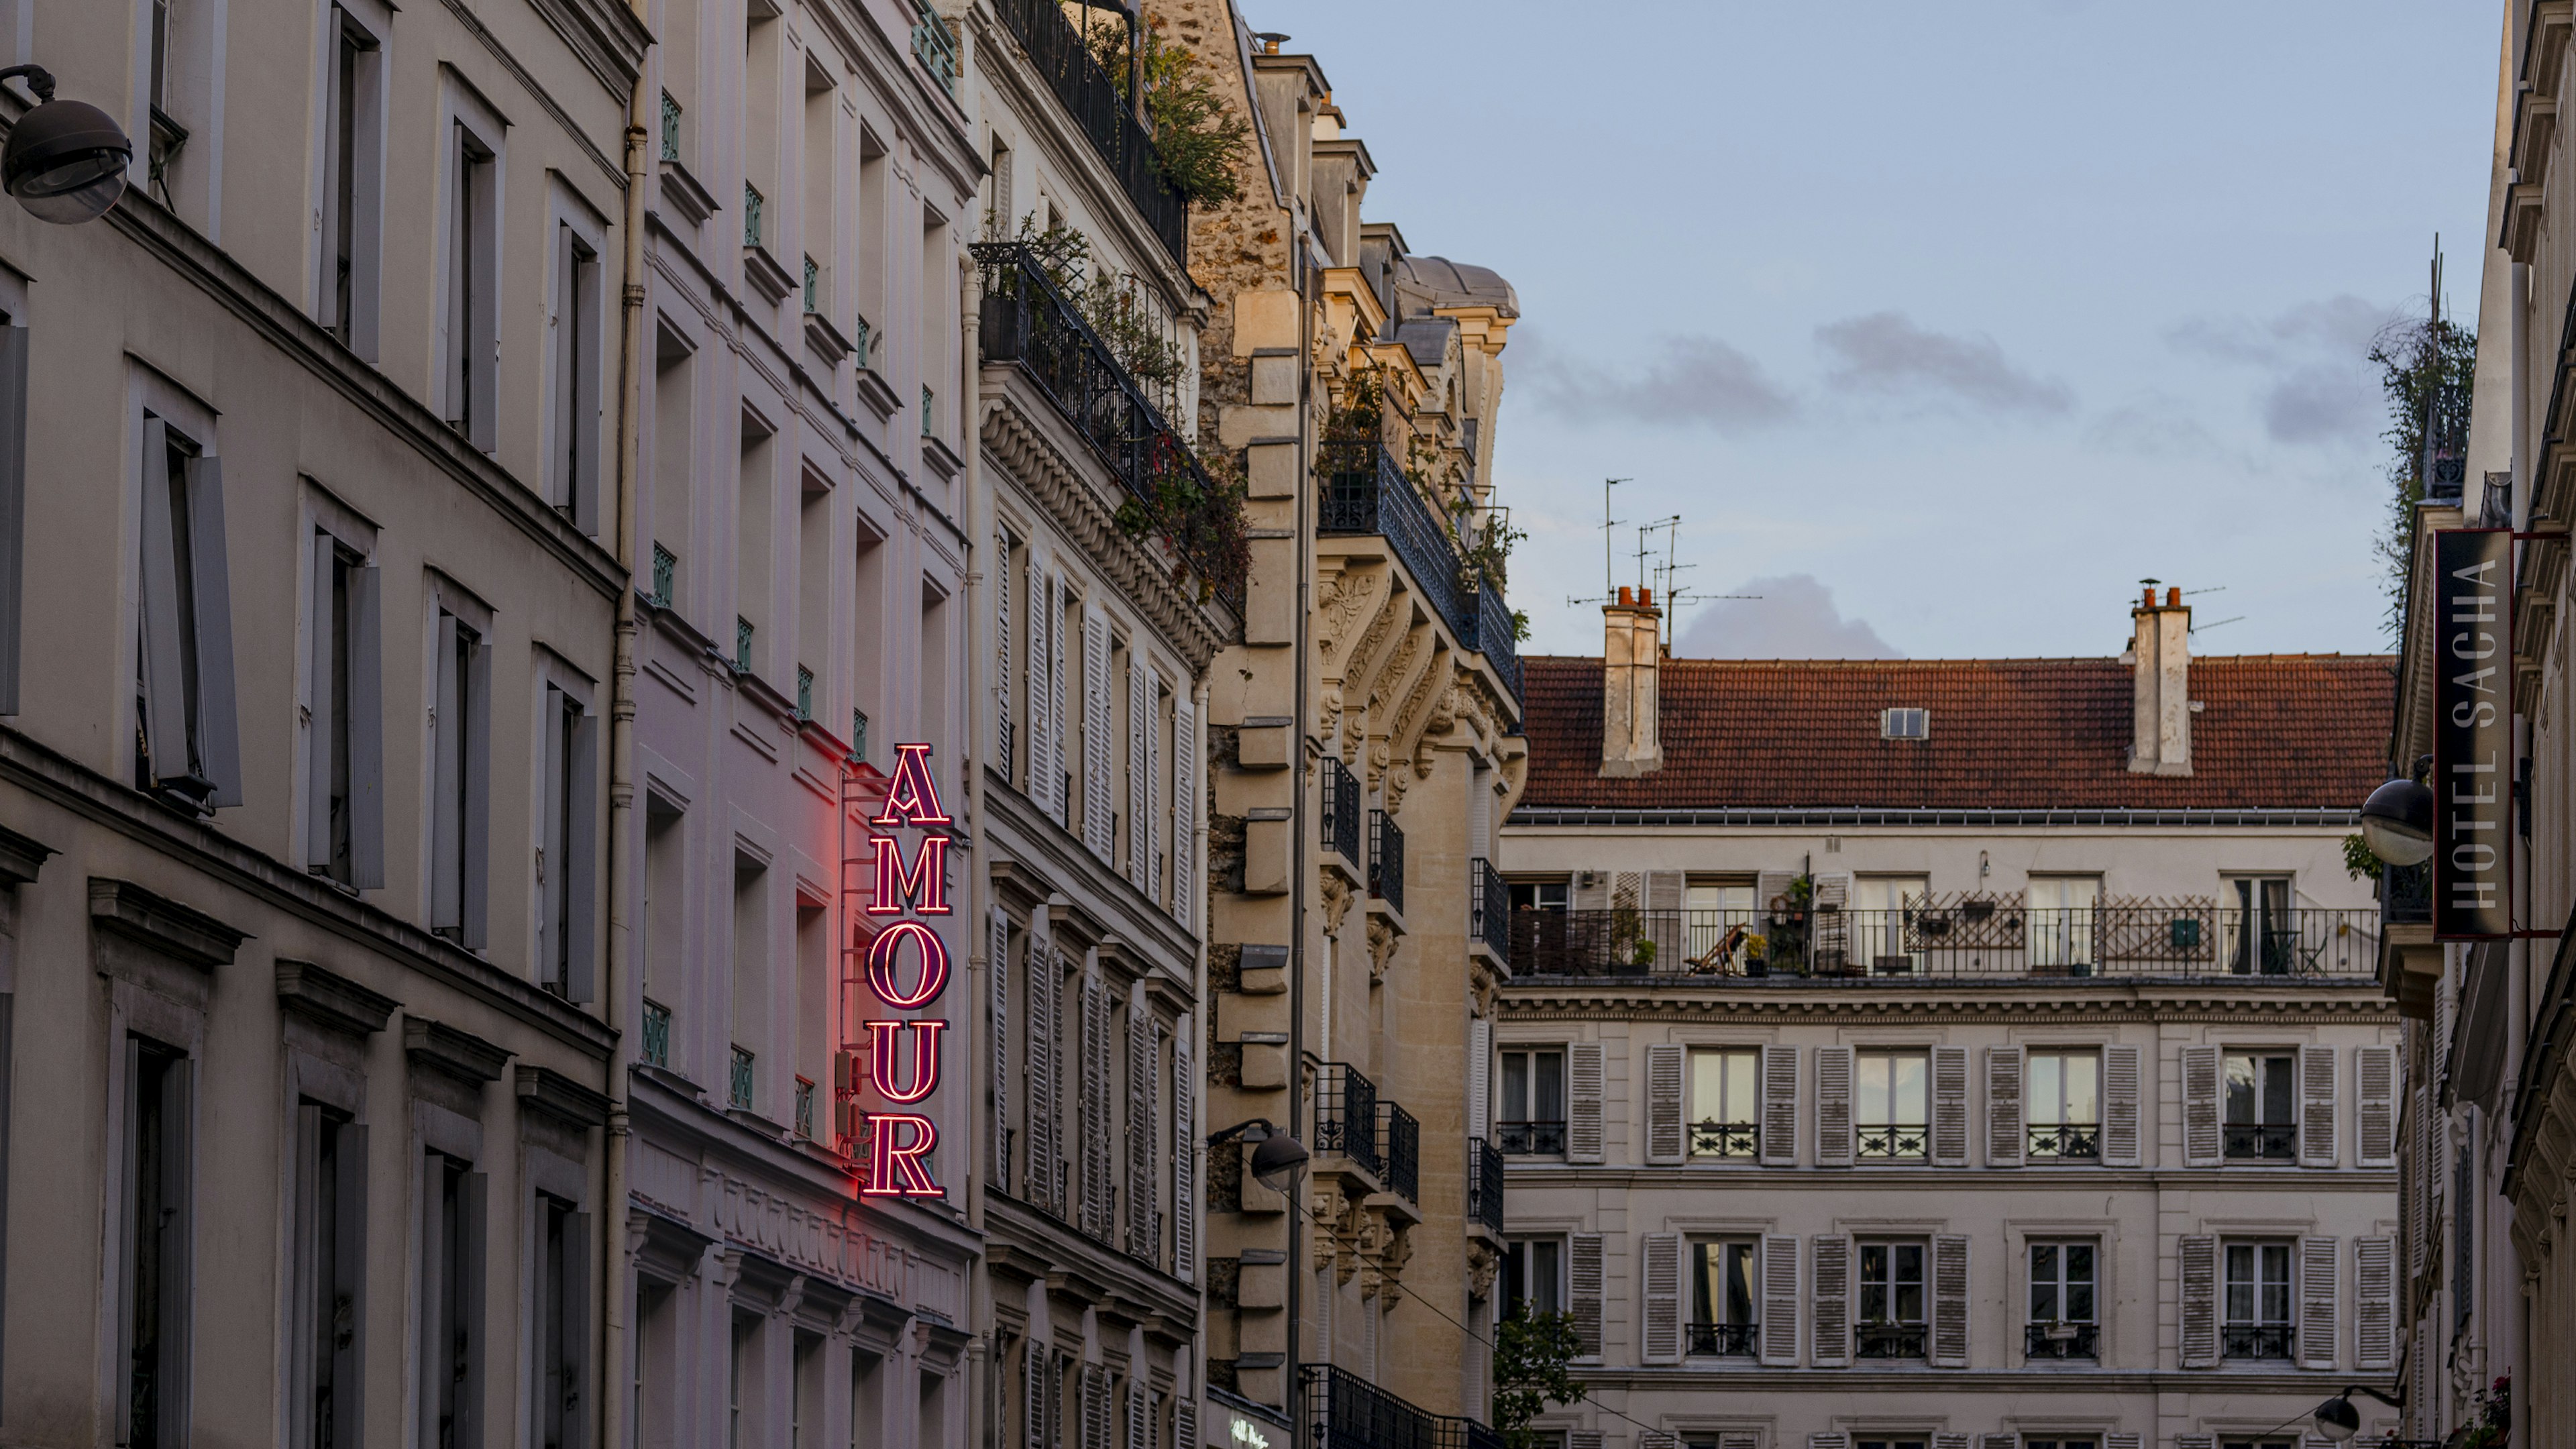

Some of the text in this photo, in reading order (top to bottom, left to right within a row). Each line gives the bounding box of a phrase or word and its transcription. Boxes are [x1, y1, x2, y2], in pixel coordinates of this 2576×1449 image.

[2452, 559, 2497, 909] HOTEL SACHA
[860, 742, 955, 1199] AMOUR
